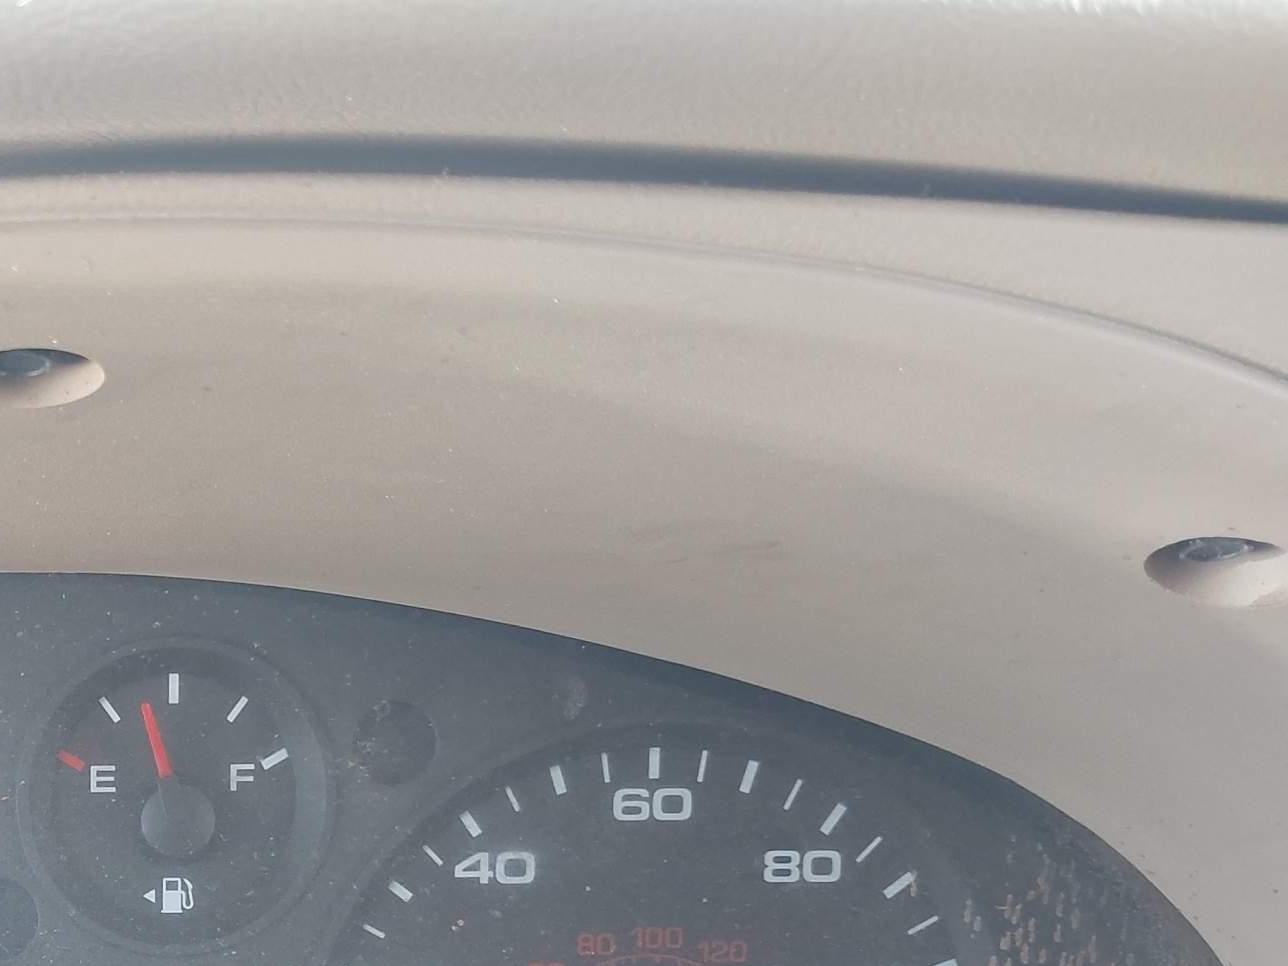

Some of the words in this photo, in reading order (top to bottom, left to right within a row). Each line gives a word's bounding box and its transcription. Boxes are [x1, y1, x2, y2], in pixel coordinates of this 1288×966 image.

[89, 765, 117, 792] E
[229, 763, 255, 791] F
[612, 788, 692, 822] 60
[454, 851, 536, 885] 40
[763, 850, 842, 884] 80
[577, 933, 616, 955] 80
[631, 927, 683, 949] 100
[698, 940, 747, 963] 120
